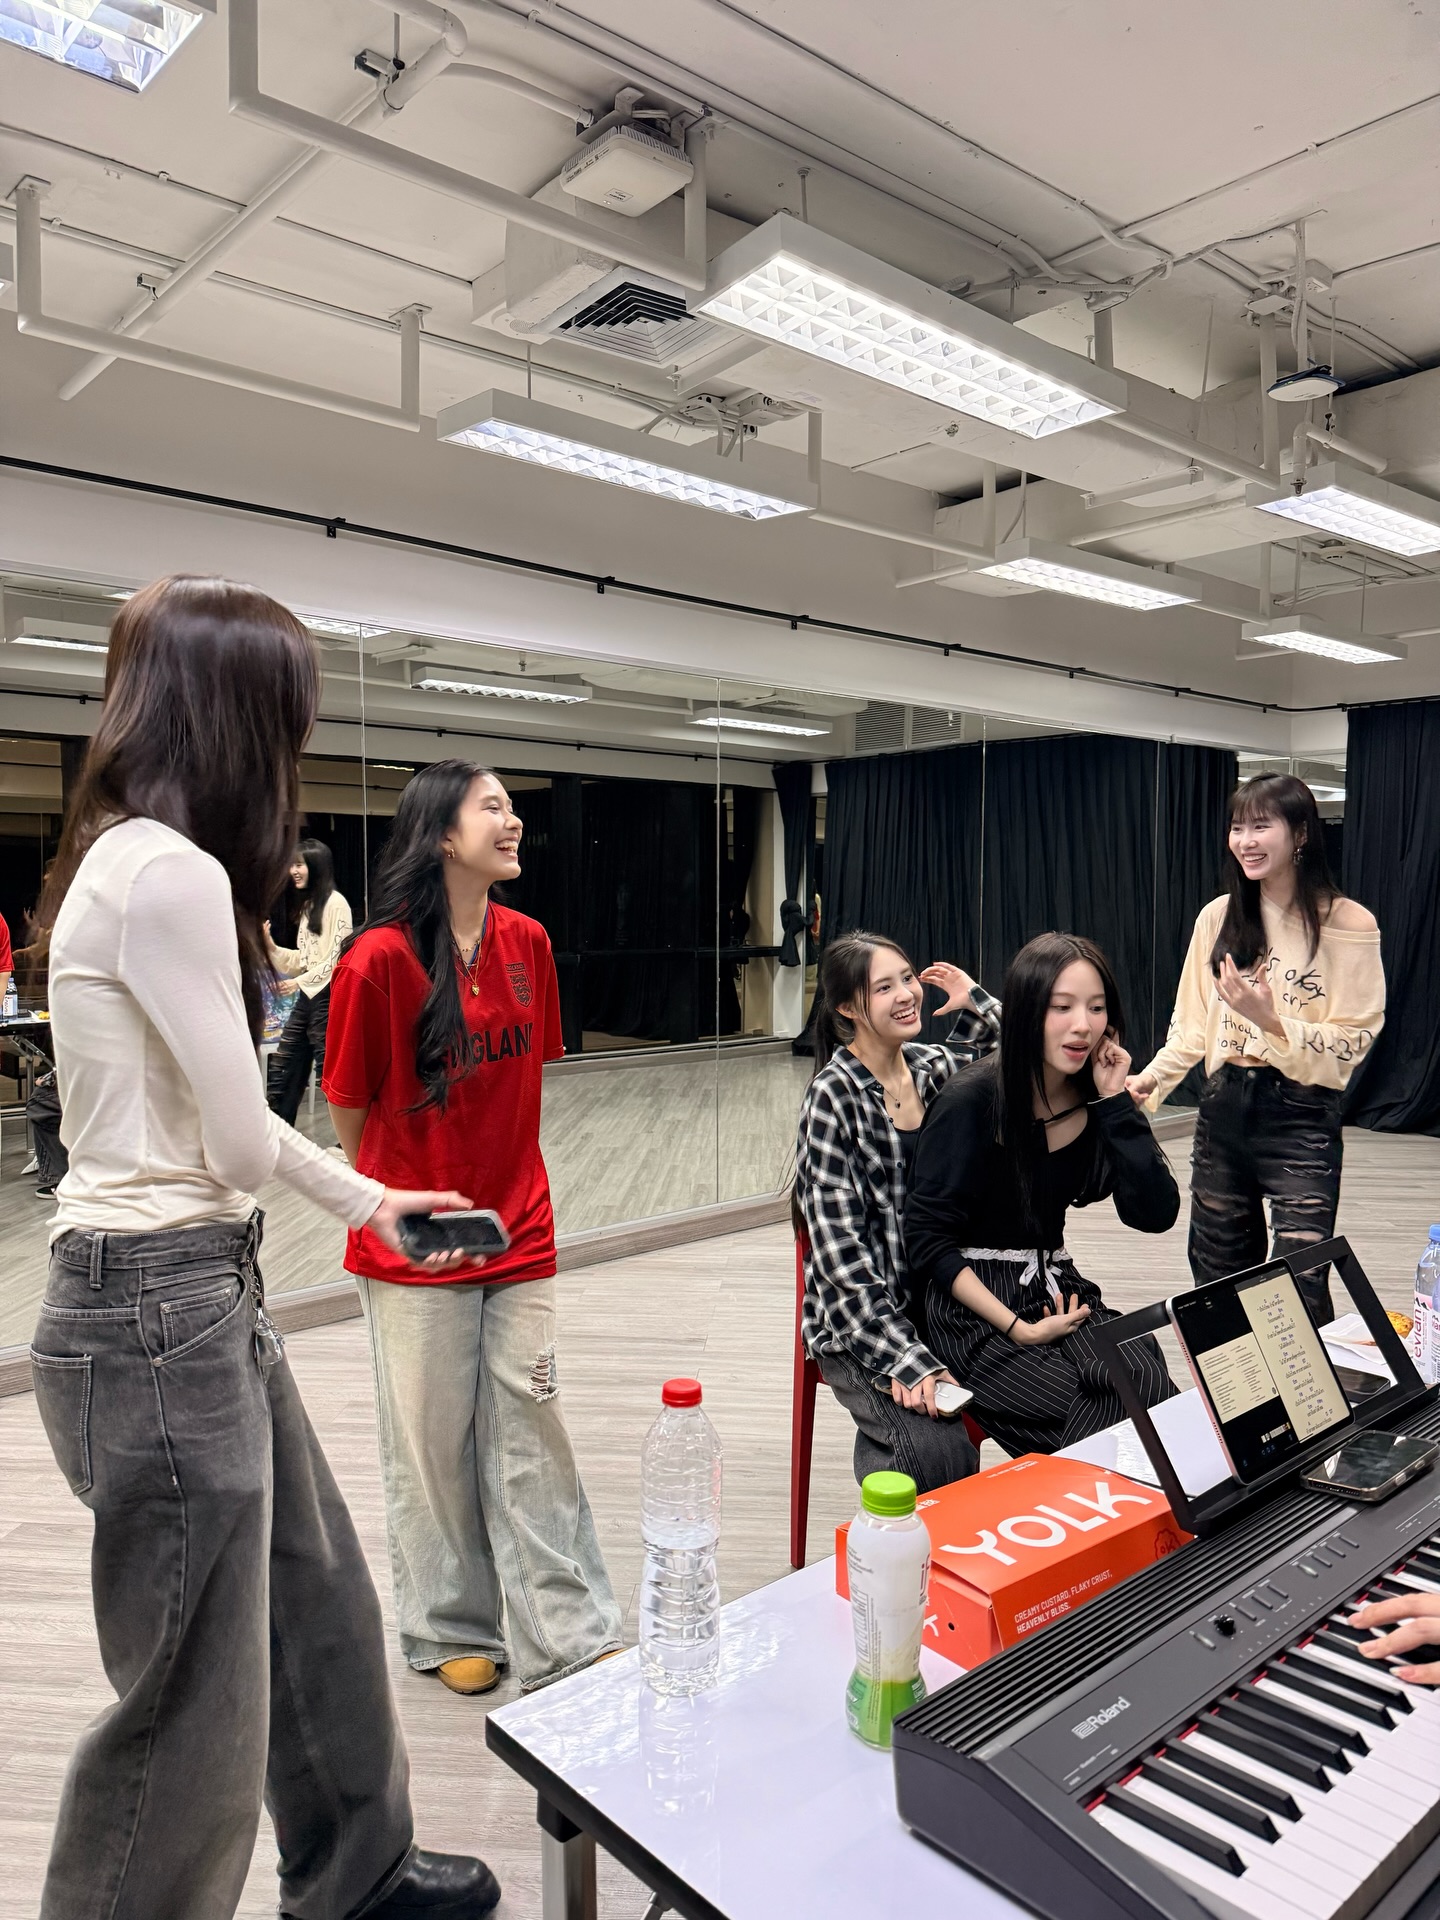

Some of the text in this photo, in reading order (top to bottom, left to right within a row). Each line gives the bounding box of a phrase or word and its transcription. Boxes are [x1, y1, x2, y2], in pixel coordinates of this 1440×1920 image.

[1414, 1308, 1422, 1358] evian
[938, 1481, 1153, 1566] YOLK
[1014, 1604, 1042, 1623] CREAMY
[1070, 1579, 1092, 1596] FLAKY
[1090, 1569, 1113, 1586] CRUST,
[1016, 1602, 1072, 1634] HEAVENLY BLISS.
[1086, 1696, 1131, 1729] Roland
